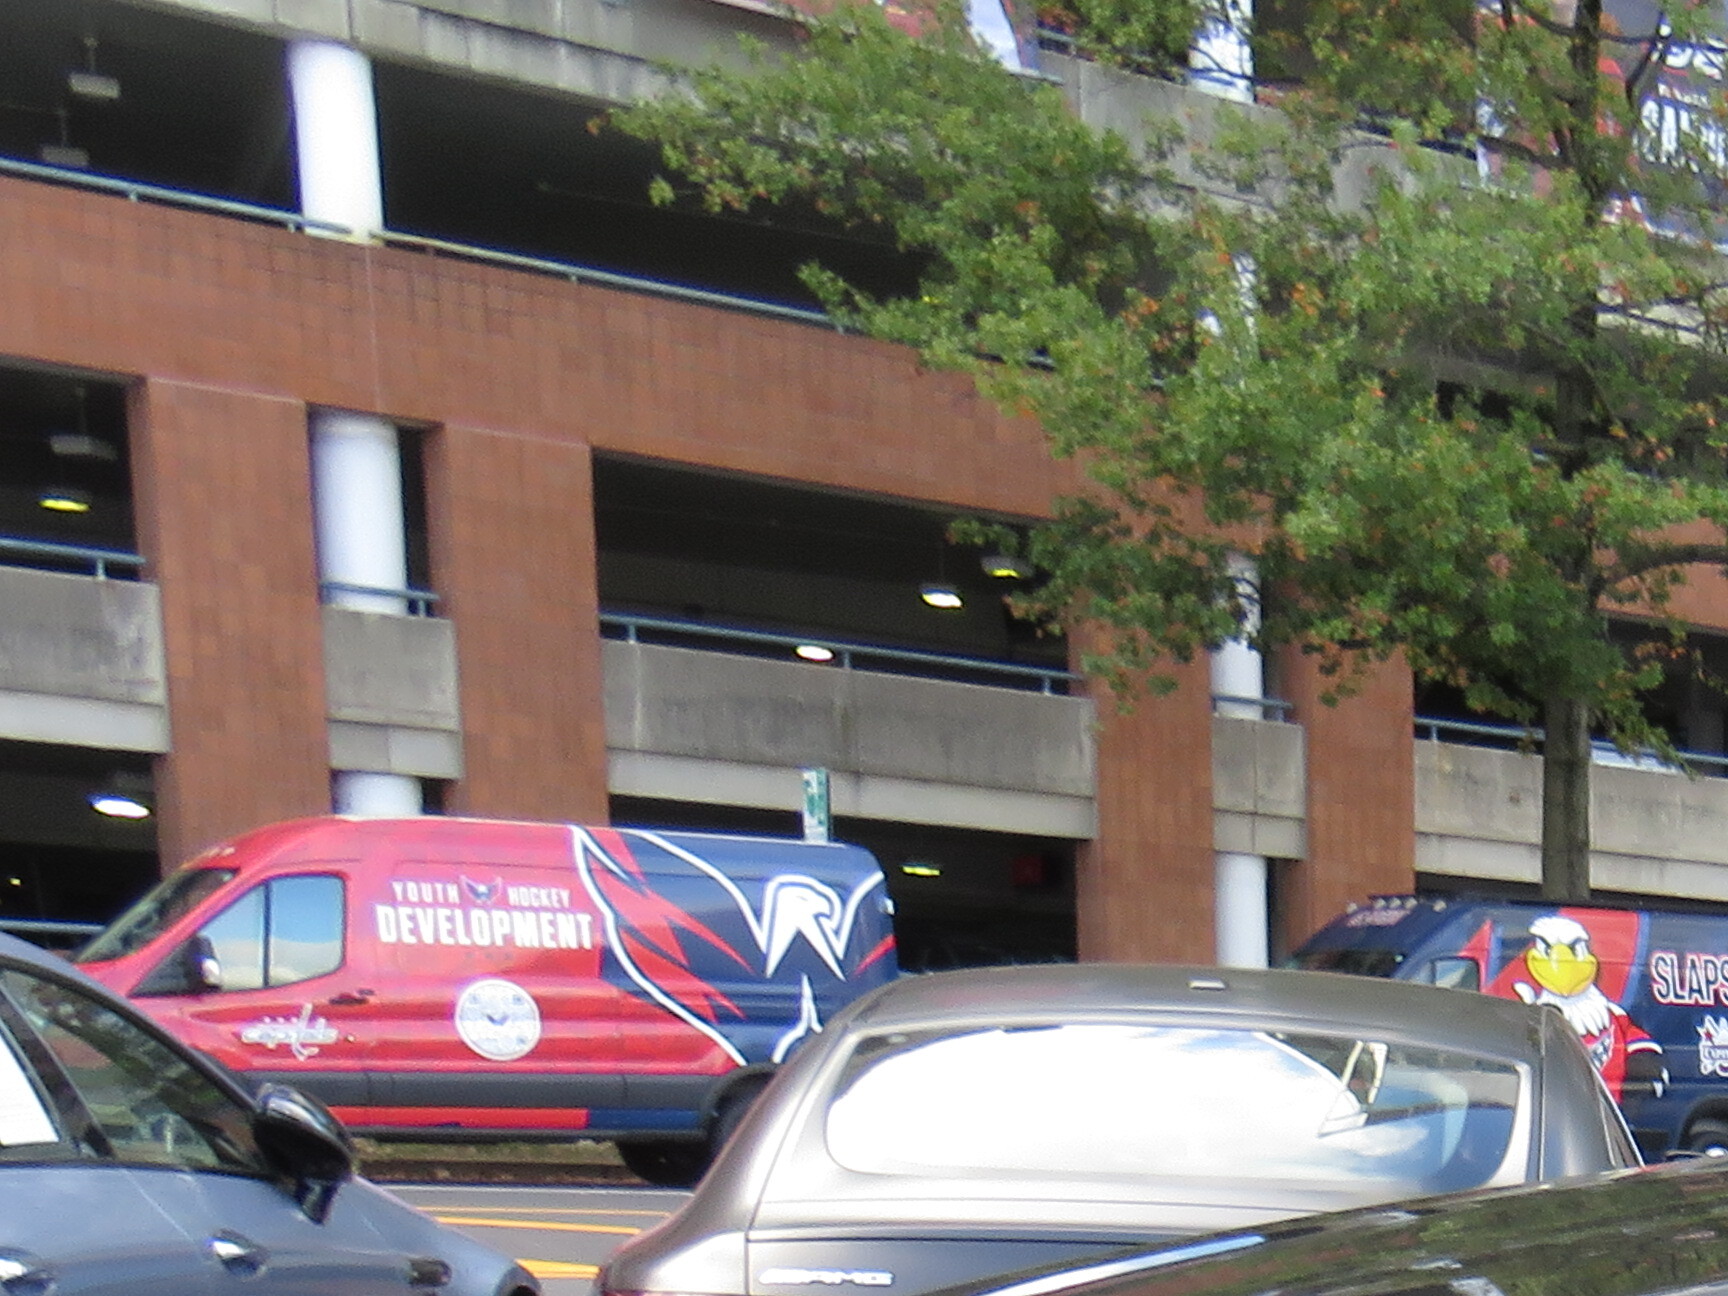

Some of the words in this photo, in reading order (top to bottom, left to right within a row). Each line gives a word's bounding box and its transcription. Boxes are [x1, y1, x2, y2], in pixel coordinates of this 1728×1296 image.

[391, 880, 460, 904] YOUTH
[507, 886, 571, 909] HOCKEY
[375, 903, 593, 950] DEVELOPMENT
